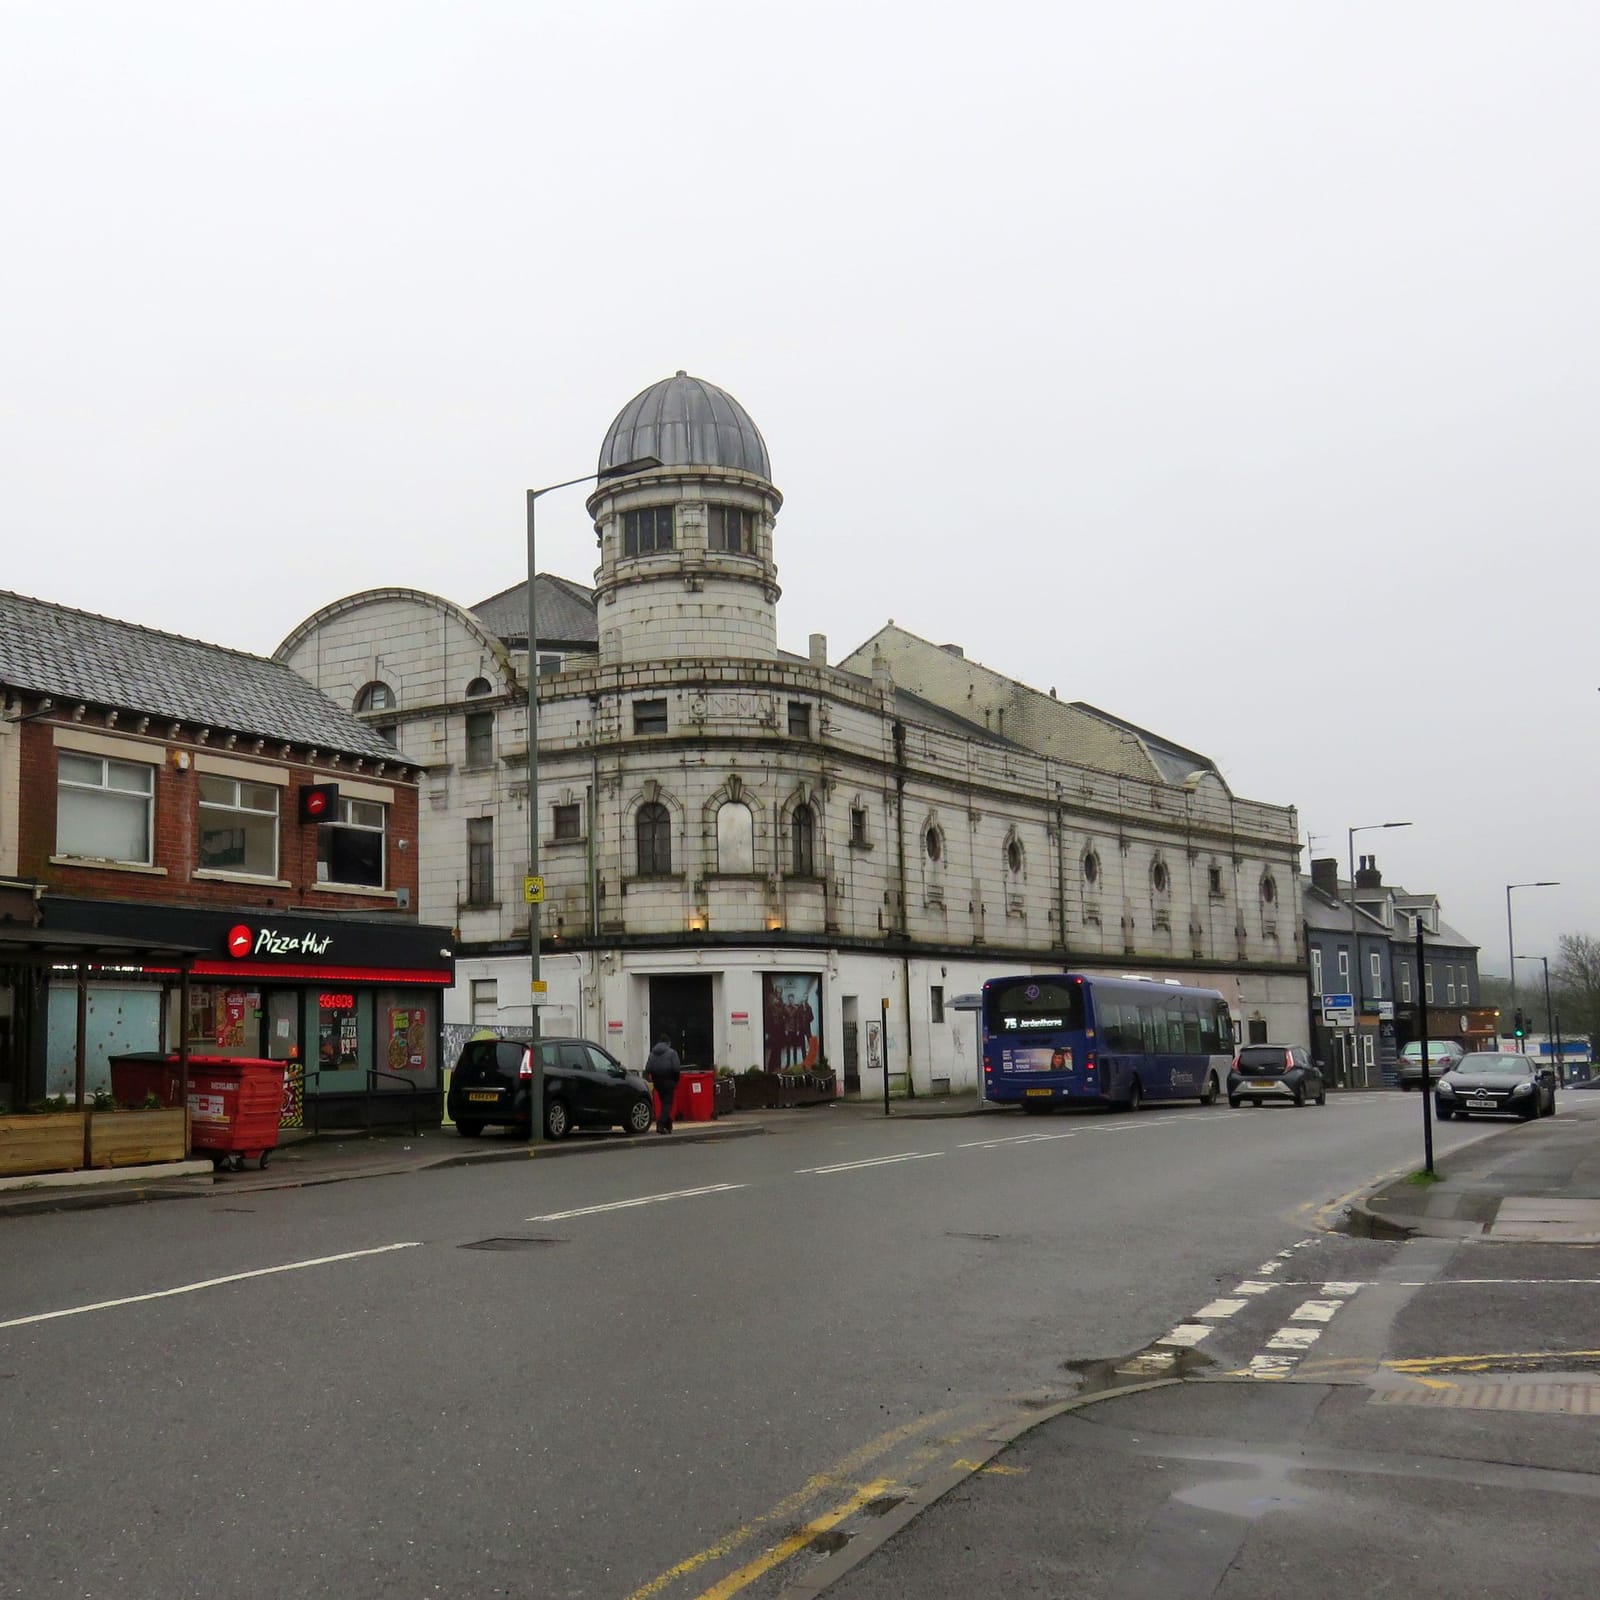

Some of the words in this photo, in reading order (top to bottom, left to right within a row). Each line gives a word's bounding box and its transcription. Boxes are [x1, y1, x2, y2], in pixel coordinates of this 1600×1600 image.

[691, 696, 769, 717] CINEMA
[254, 928, 300, 955] Pizza
[301, 931, 334, 955] Hut
[1004, 1017, 1018, 1029] 75
[340, 1026, 357, 1038] PIZZA
